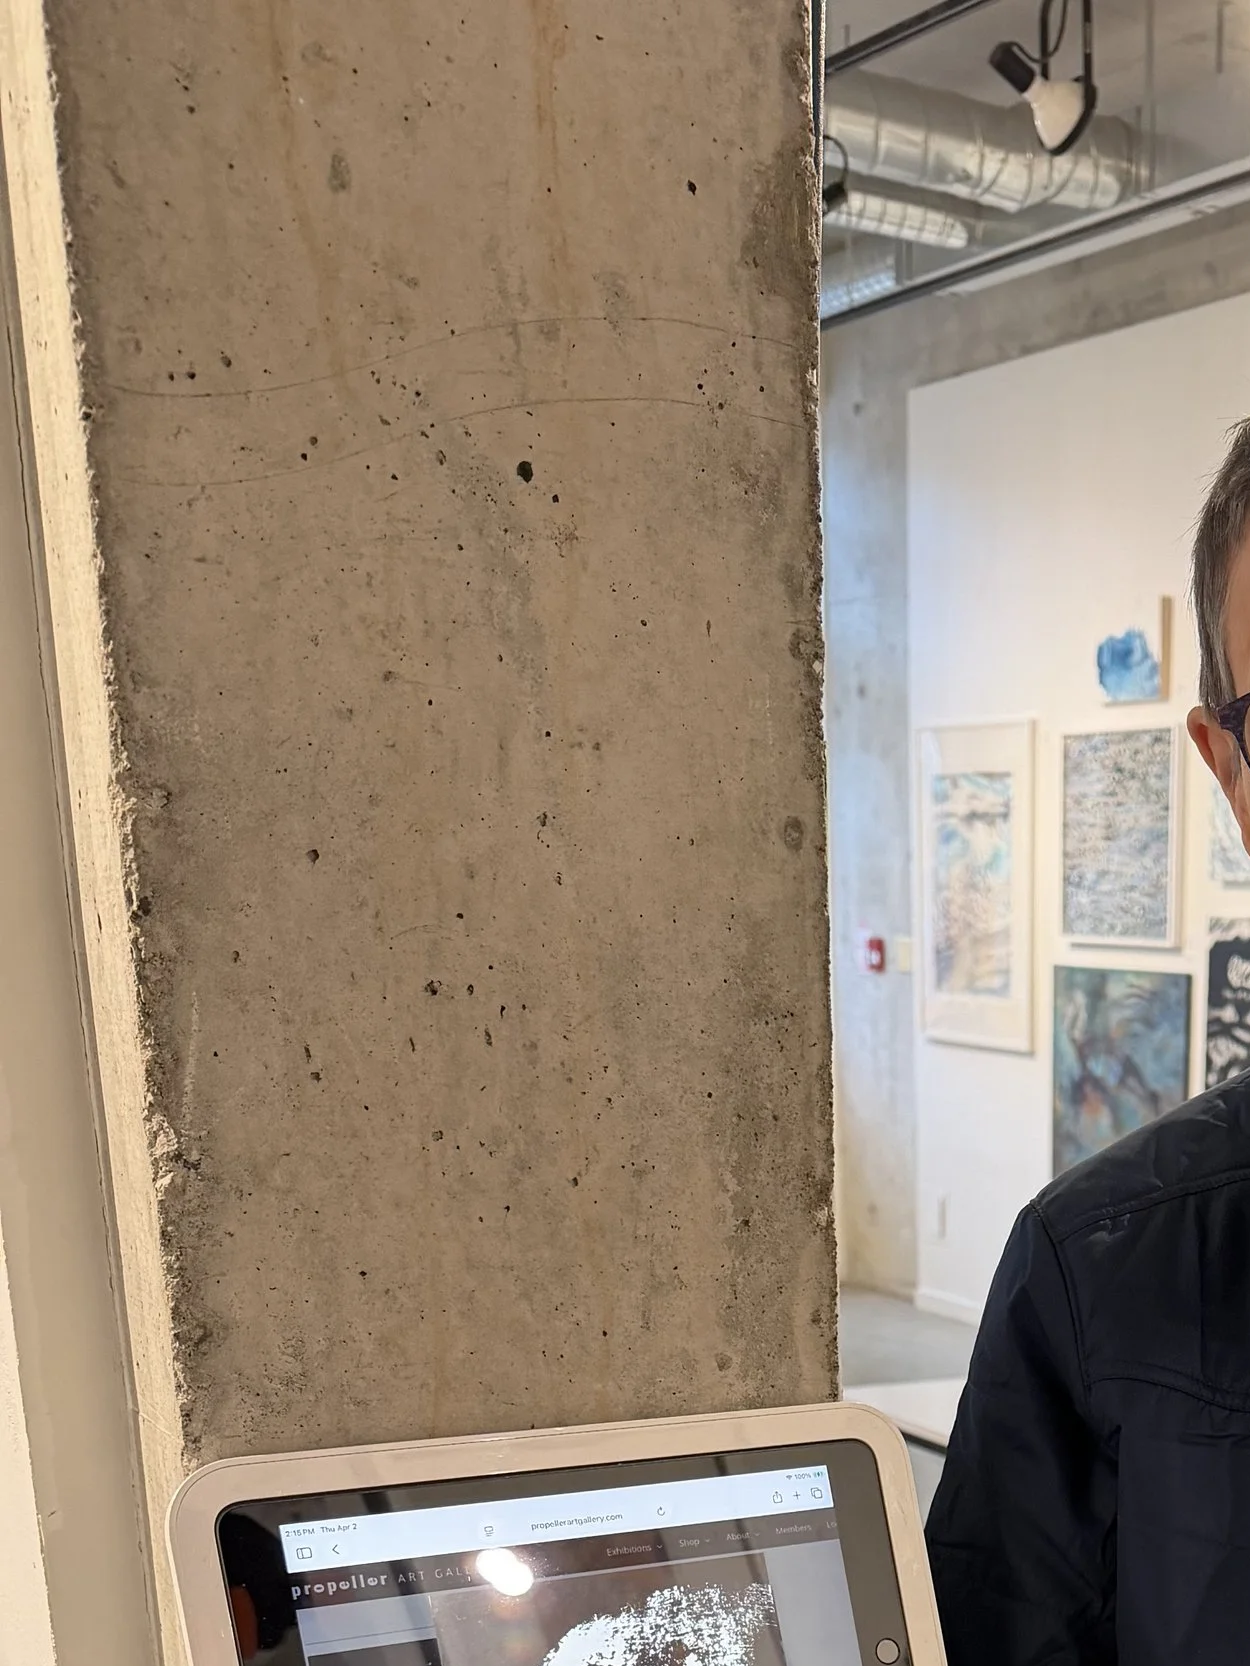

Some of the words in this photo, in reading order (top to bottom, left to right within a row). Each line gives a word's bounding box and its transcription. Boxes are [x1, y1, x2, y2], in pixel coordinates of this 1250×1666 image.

[794, 1472, 812, 1480] 100%
[320, 1526, 336, 1534] Thu
[337, 1524, 351, 1533] Apr
[531, 1513, 623, 1531] propellerartgallery.com
[606, 1544, 652, 1557] Exhibitions
[679, 1538, 700, 1548] Shop
[726, 1532, 751, 1541] About
[775, 1523, 813, 1535] Members
[398, 1570, 425, 1584] ART
[291, 1574, 388, 1600] propeller
